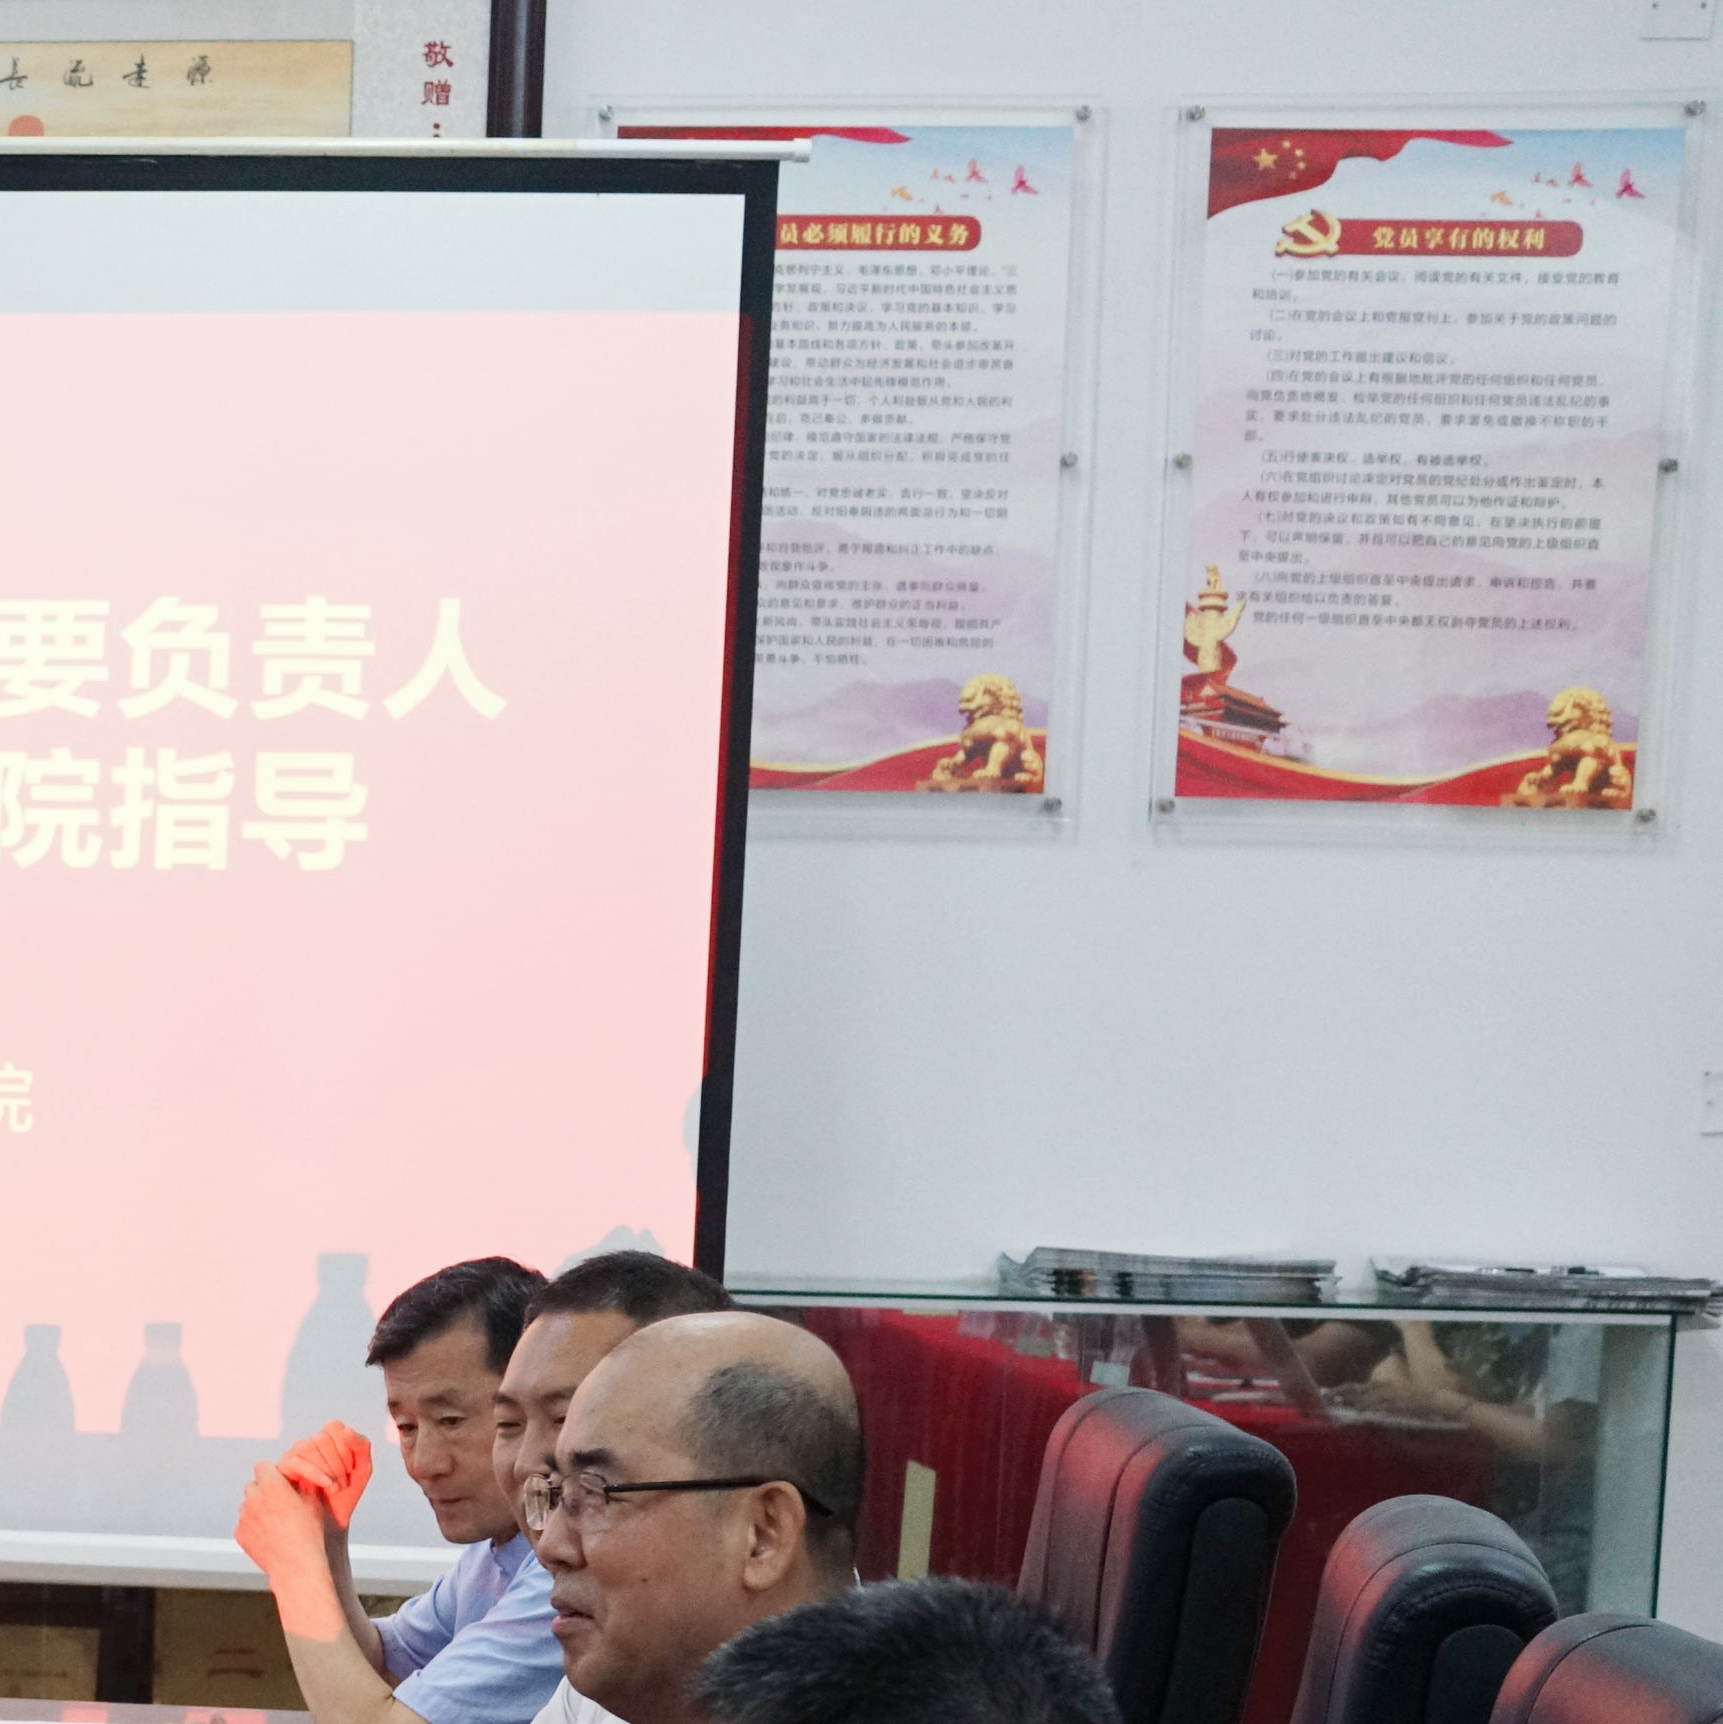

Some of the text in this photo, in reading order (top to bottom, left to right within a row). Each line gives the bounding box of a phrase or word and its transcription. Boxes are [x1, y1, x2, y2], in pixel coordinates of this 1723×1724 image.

[780, 222, 969, 246] 员必须履行的义务
[1372, 227, 1546, 250] 党员享有的权利
